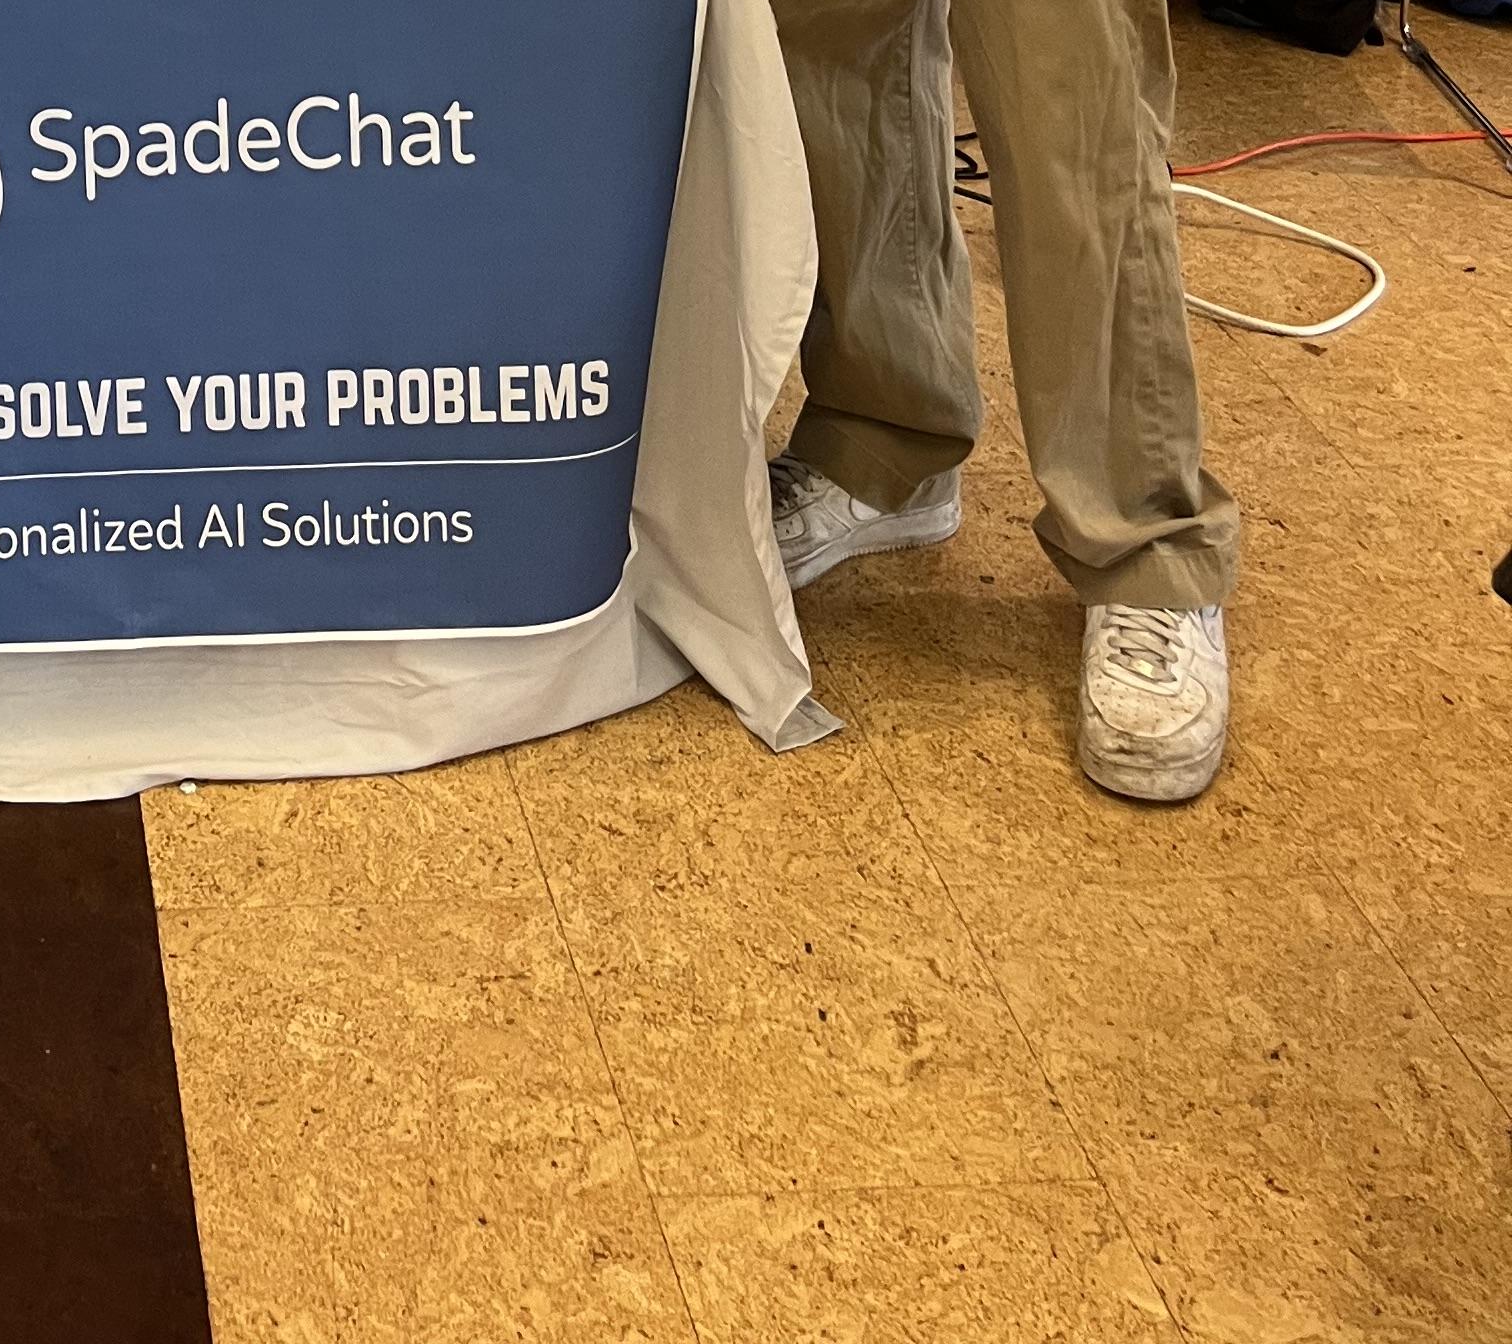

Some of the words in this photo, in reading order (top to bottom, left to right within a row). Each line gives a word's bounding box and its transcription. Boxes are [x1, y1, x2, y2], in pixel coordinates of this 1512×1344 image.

[28, 92, 478, 201] SpadeChat
[165, 370, 307, 433] YOUR
[326, 359, 610, 426] PROBLEMS
[198, 503, 246, 549] AI
[262, 498, 474, 548] Solutions
